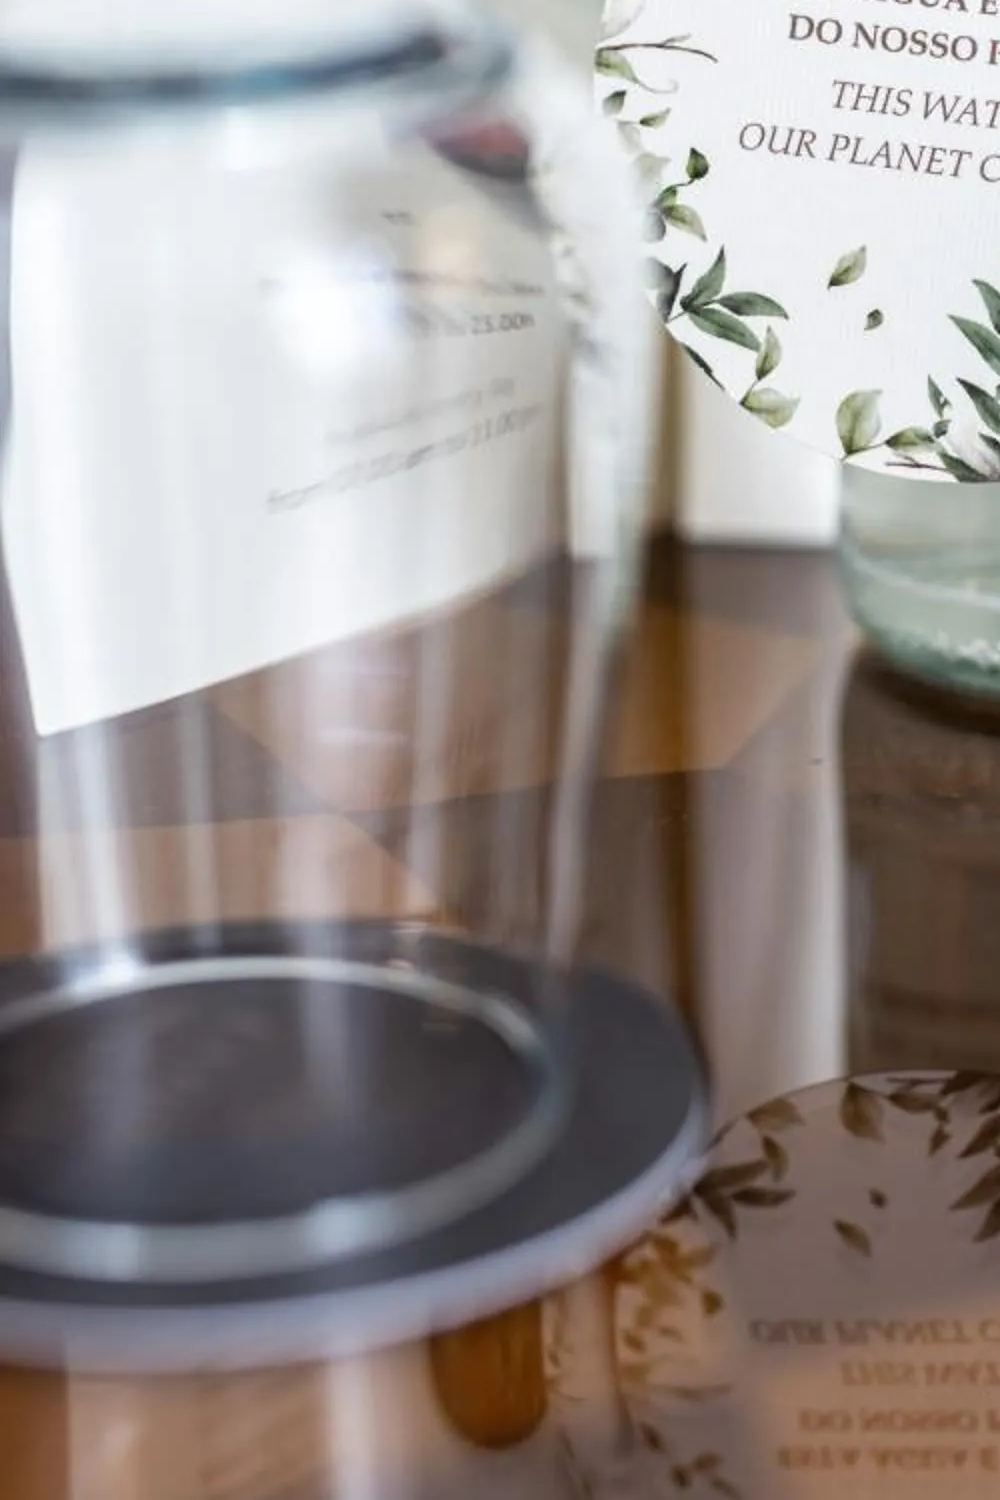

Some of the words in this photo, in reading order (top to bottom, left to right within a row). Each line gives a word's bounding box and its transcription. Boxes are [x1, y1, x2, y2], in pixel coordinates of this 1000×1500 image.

[788, 12, 843, 45] DO
[851, 21, 978, 62] NOSSO
[831, 79, 913, 118] THIS
[738, 122, 818, 160] OUR
[826, 132, 974, 178] PLANET
